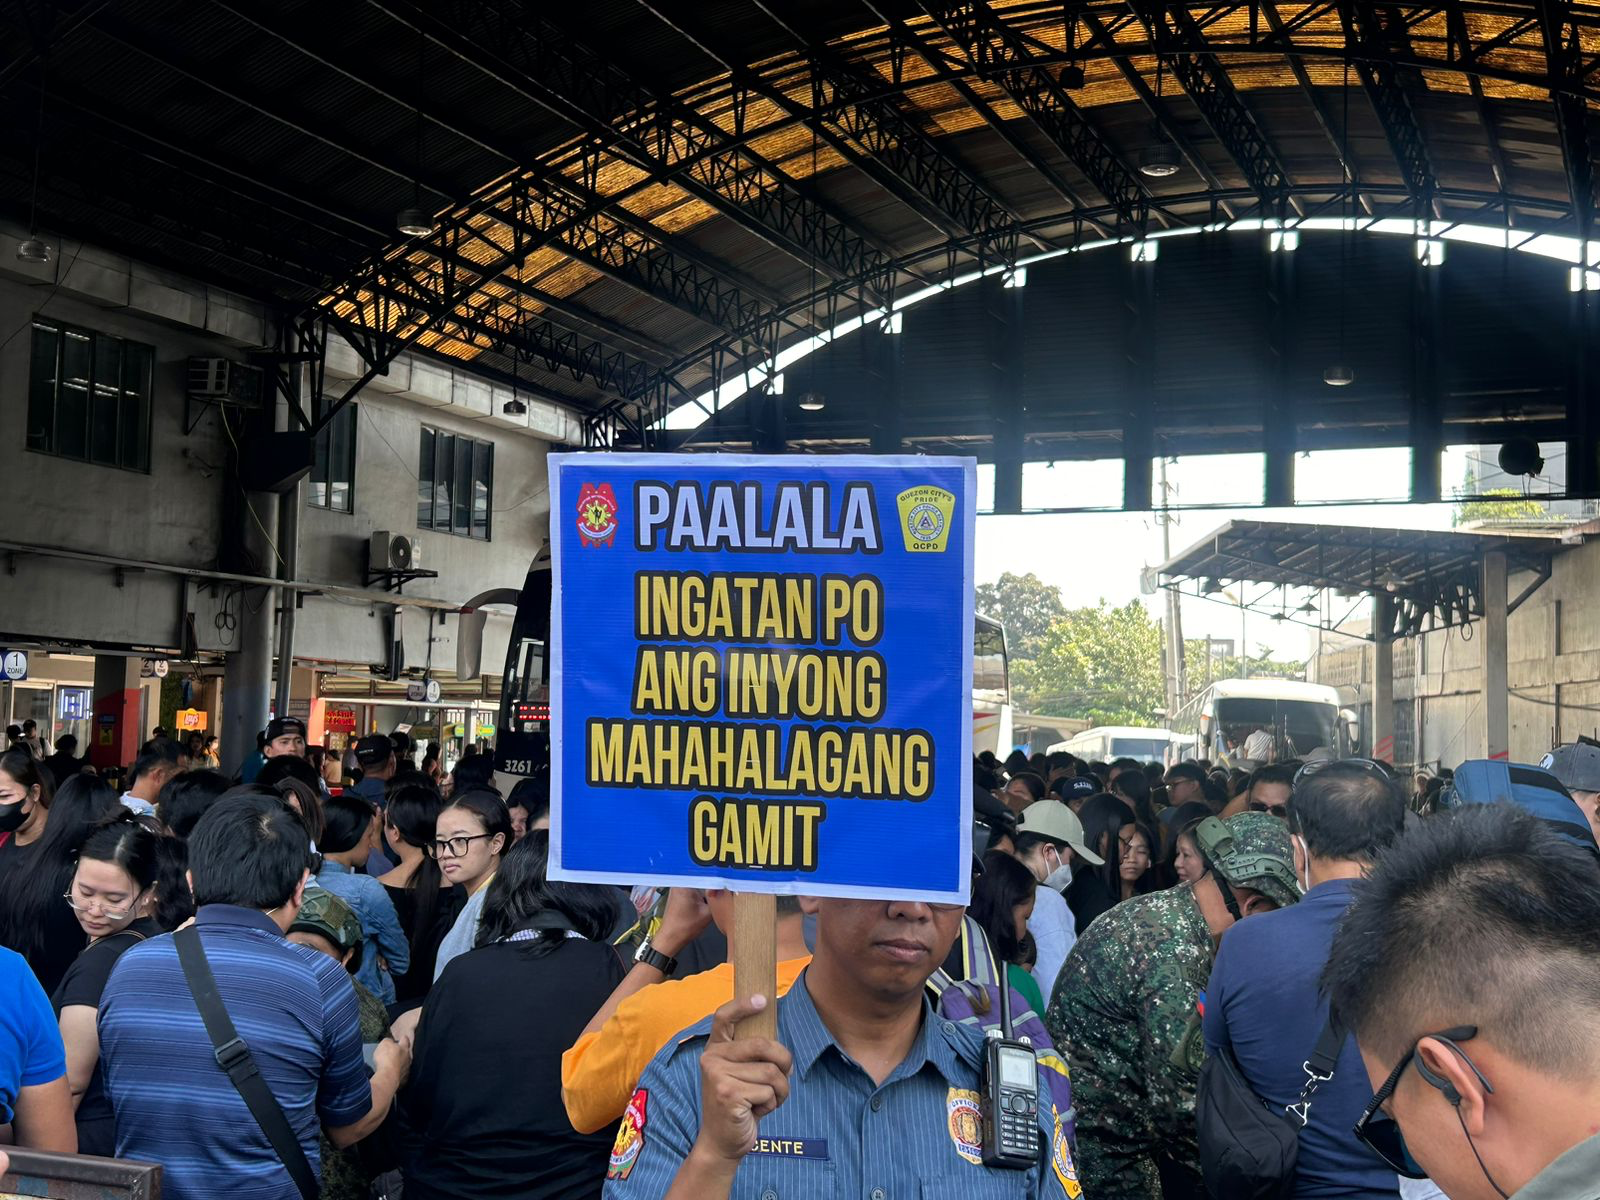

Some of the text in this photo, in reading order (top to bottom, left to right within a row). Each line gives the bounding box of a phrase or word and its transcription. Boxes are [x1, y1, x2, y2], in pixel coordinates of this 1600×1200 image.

[638, 484, 880, 551] PAALALA
[900, 490, 952, 502] QUEZON CITY'S
[638, 574, 880, 643] INGATAN PO
[13, 652, 18, 666] 1
[635, 649, 883, 718] ANG INYONG
[504, 759, 532, 774] 3261
[589, 722, 931, 798] MAHAHALAGANG
[692, 799, 822, 867] GAMIT
